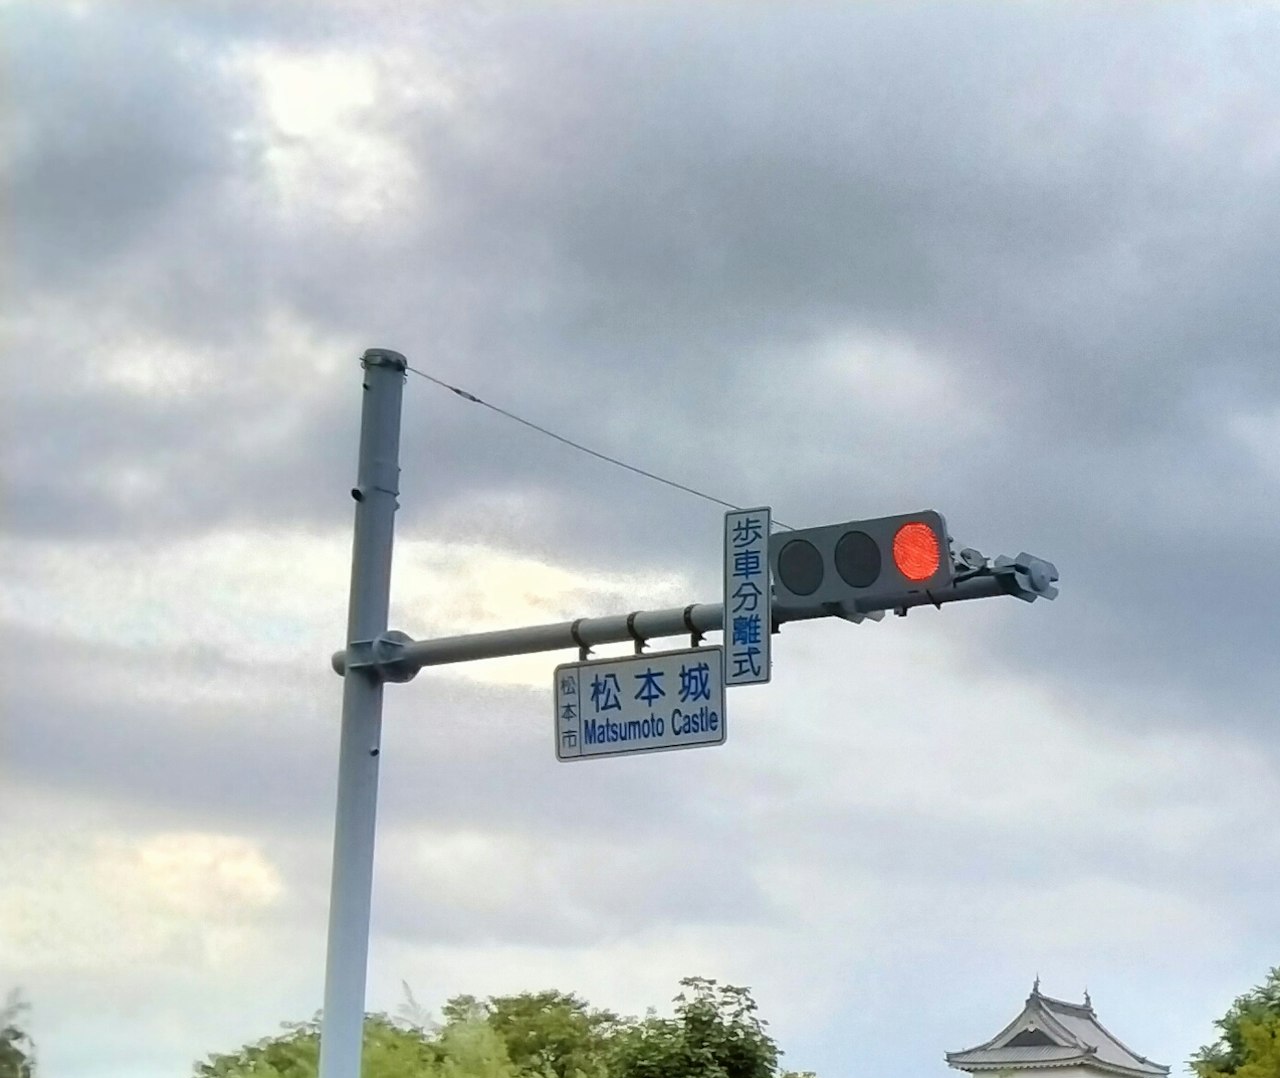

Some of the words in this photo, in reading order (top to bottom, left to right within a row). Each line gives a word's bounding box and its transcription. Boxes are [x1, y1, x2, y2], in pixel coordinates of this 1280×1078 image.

[732, 517, 763, 679] 歩車分離式
[560, 676, 578, 749] 松本市
[590, 662, 711, 713] 松本城
[584, 713, 665, 745] Matsumoto
[671, 706, 719, 736] Castle
